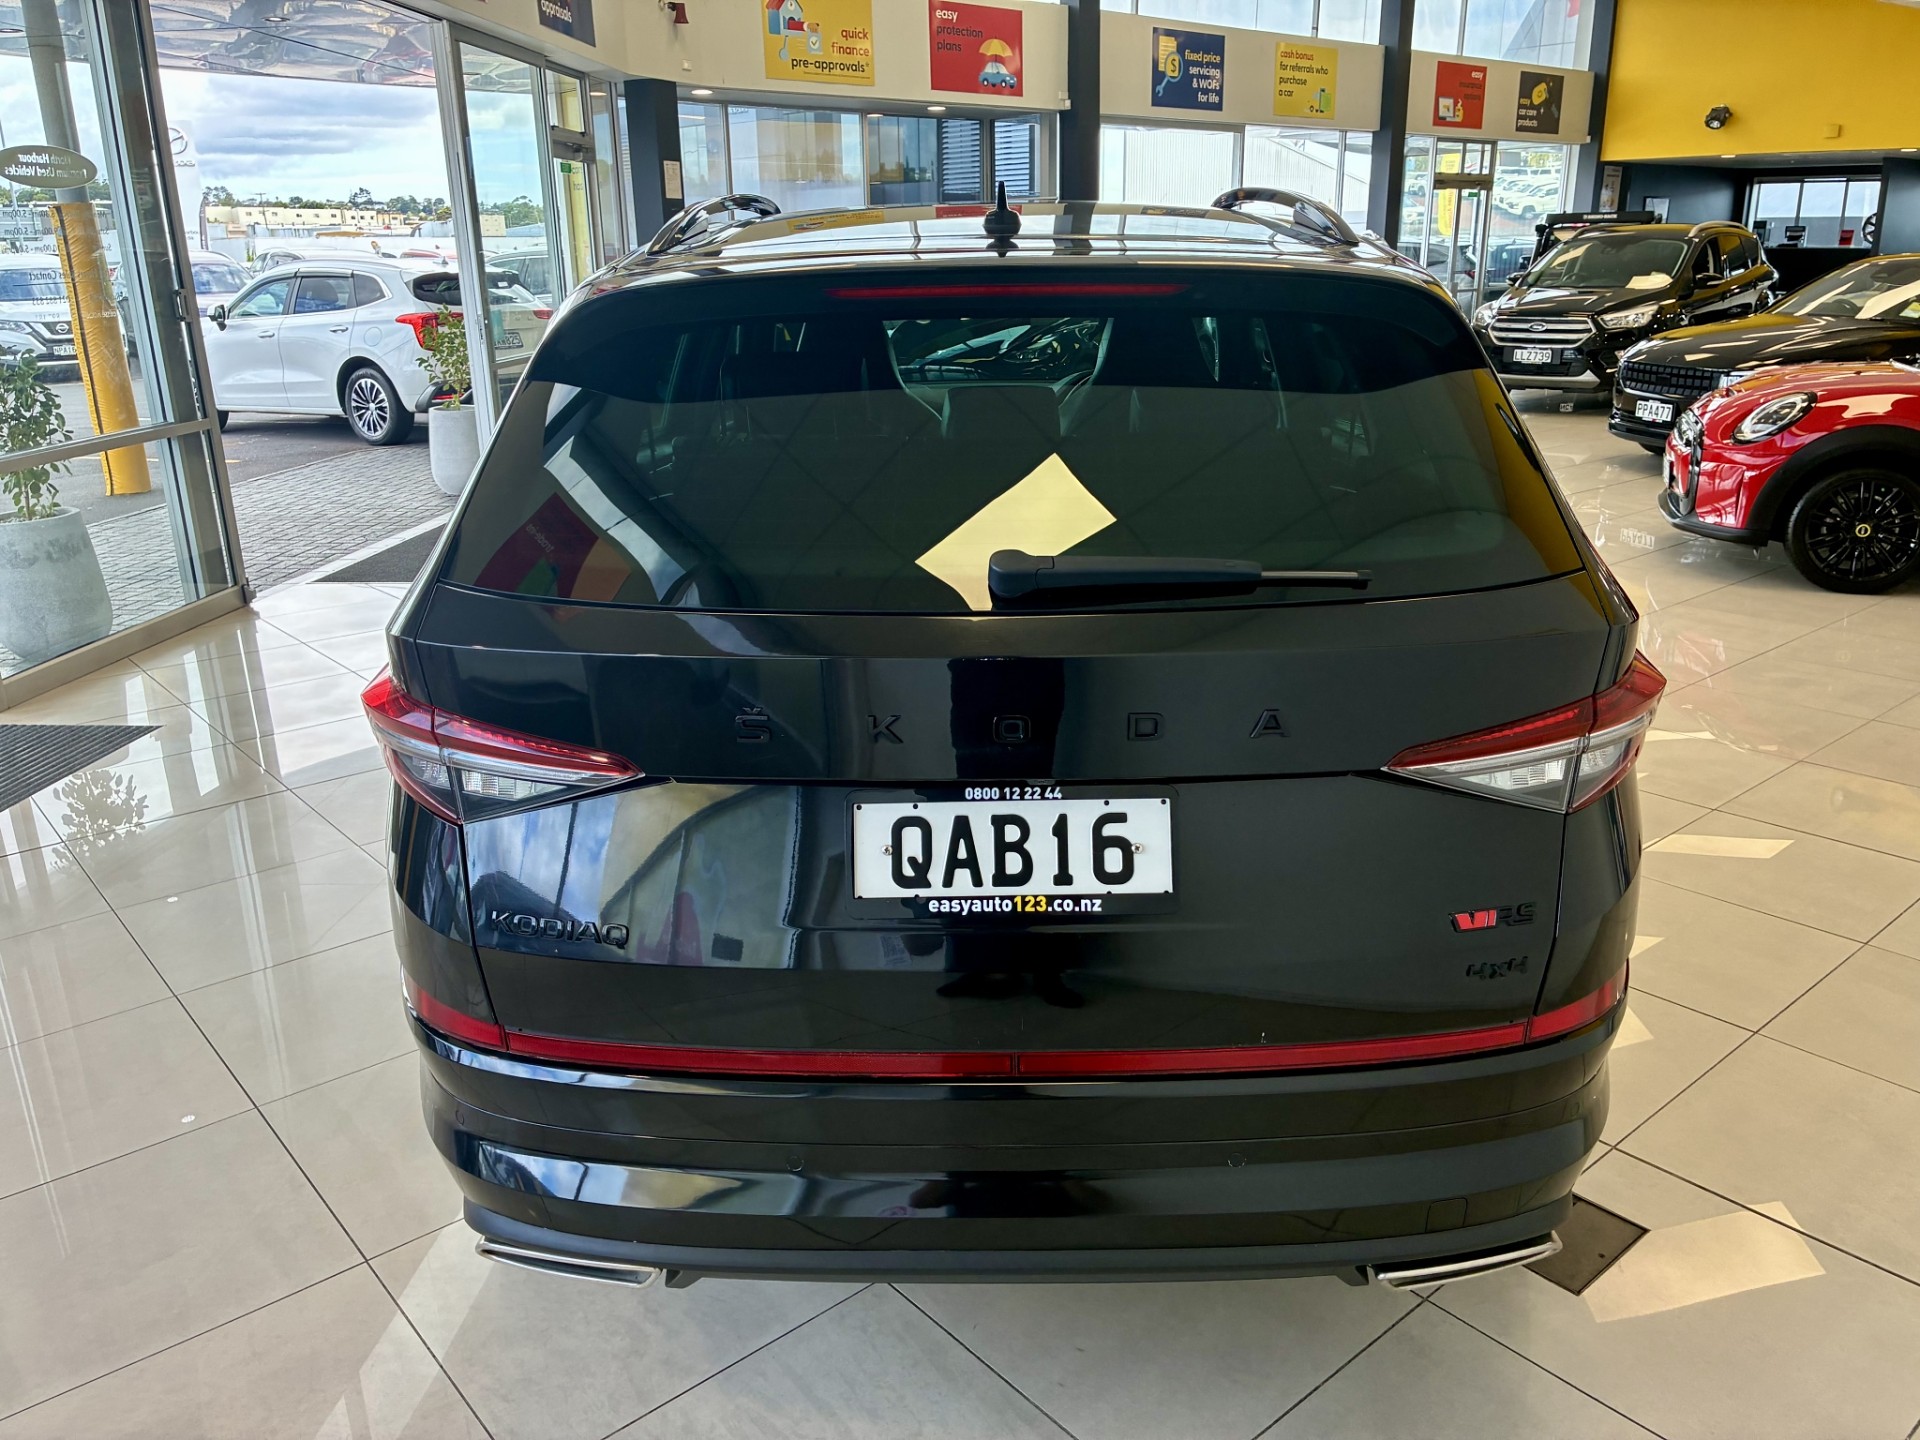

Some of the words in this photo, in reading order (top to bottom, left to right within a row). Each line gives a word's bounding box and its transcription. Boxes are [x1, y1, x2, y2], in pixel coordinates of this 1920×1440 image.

[541, 1, 572, 23] appraisals
[935, 9, 958, 23] easy
[841, 28, 869, 41] quick
[936, 25, 983, 38] protection
[831, 42, 870, 57] finance
[937, 39, 962, 52] plans
[1185, 49, 1203, 61] fixed
[1203, 52, 1221, 64] price
[1280, 50, 1294, 59] cash
[1296, 50, 1314, 61] bonus
[1189, 65, 1220, 79] servicing
[1279, 61, 1288, 71] for
[1289, 62, 1314, 74] referrals
[1315, 65, 1328, 75] who
[1279, 75, 1307, 86] purchase
[1471, 71, 1483, 80] easy
[1192, 78, 1198, 88] &
[1199, 78, 1220, 90] WOFs
[1198, 92, 1208, 102] for
[1209, 92, 1219, 103] life
[1284, 89, 1294, 97] car
[1520, 98, 1531, 107] easy
[1517, 118, 1538, 127] products
[1514, 351, 1551, 361] LLZ739
[1636, 403, 1671, 419] PPA477
[964, 787, 999, 800] 0800
[1003, 787, 1020, 799] 12
[1023, 787, 1041, 799] 22
[1044, 787, 1062, 799] 44
[891, 812, 1135, 889] QAB16
[928, 896, 1102, 915] easyauto123.co.nz
[491, 910, 630, 950] KODIAQ
